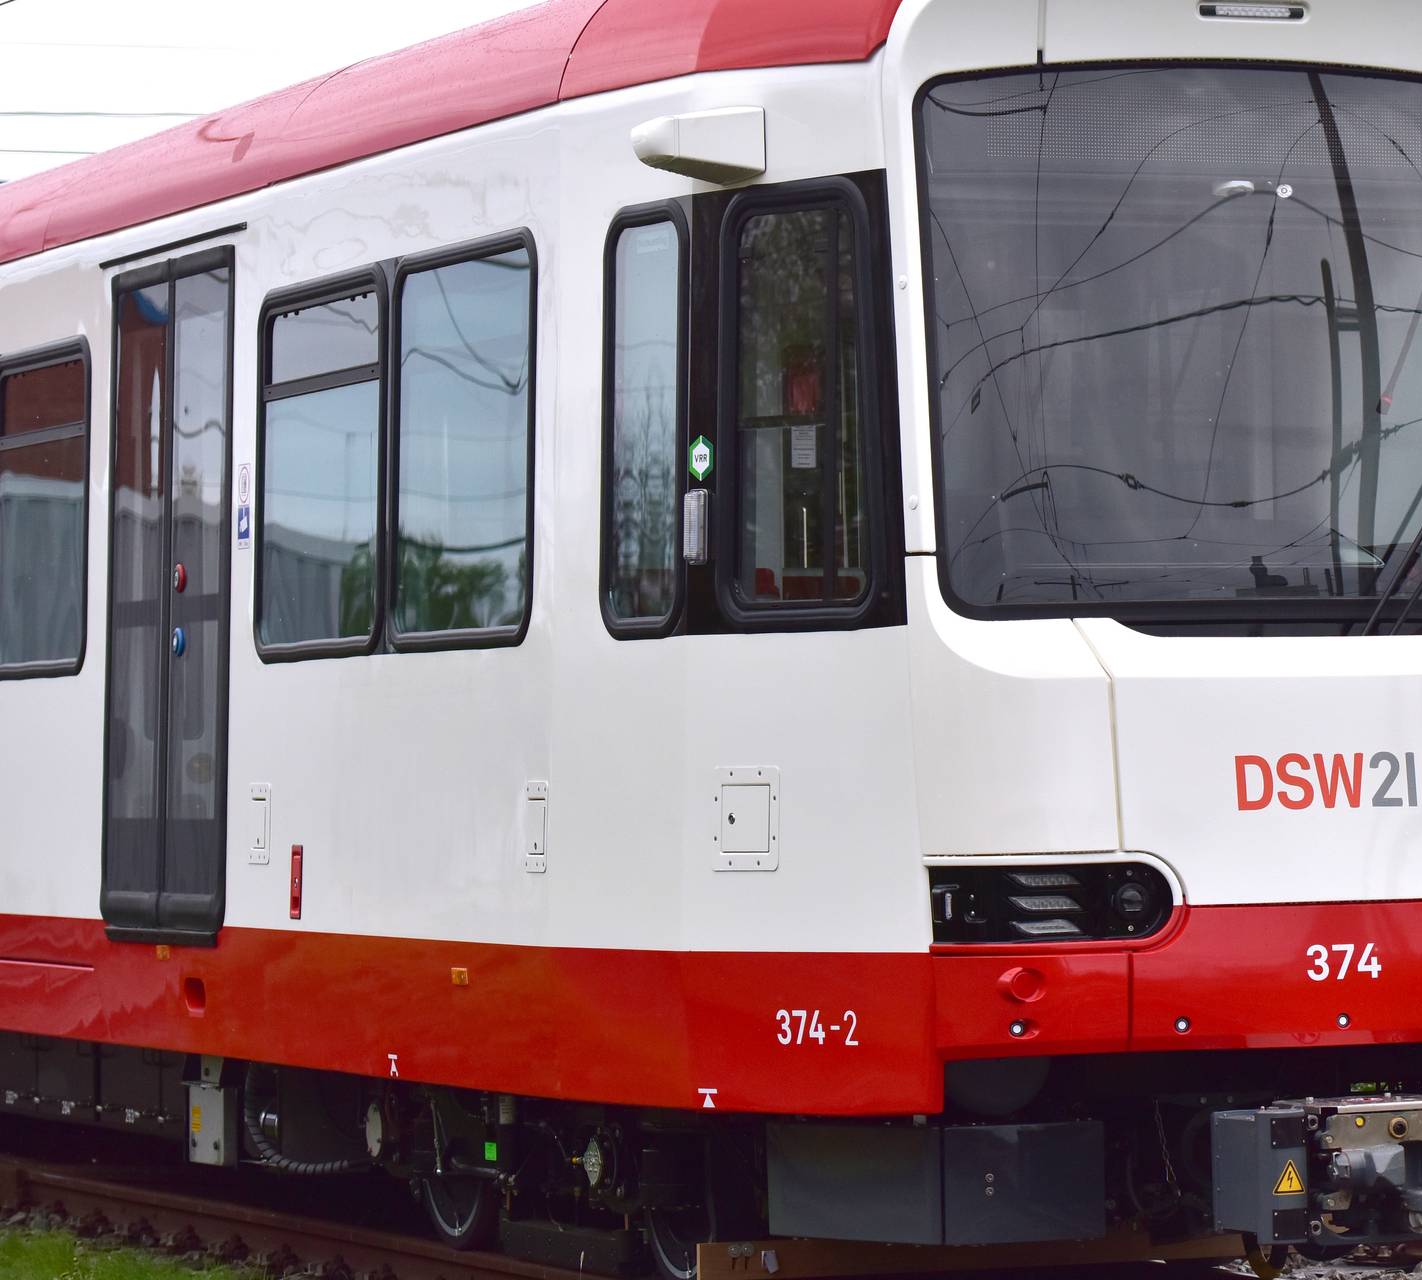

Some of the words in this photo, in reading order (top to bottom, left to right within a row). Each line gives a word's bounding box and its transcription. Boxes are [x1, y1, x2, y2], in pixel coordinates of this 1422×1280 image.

[694, 454, 708, 463] VRR
[1306, 943, 1382, 981] 374
[775, 1009, 859, 1046] 374-2
